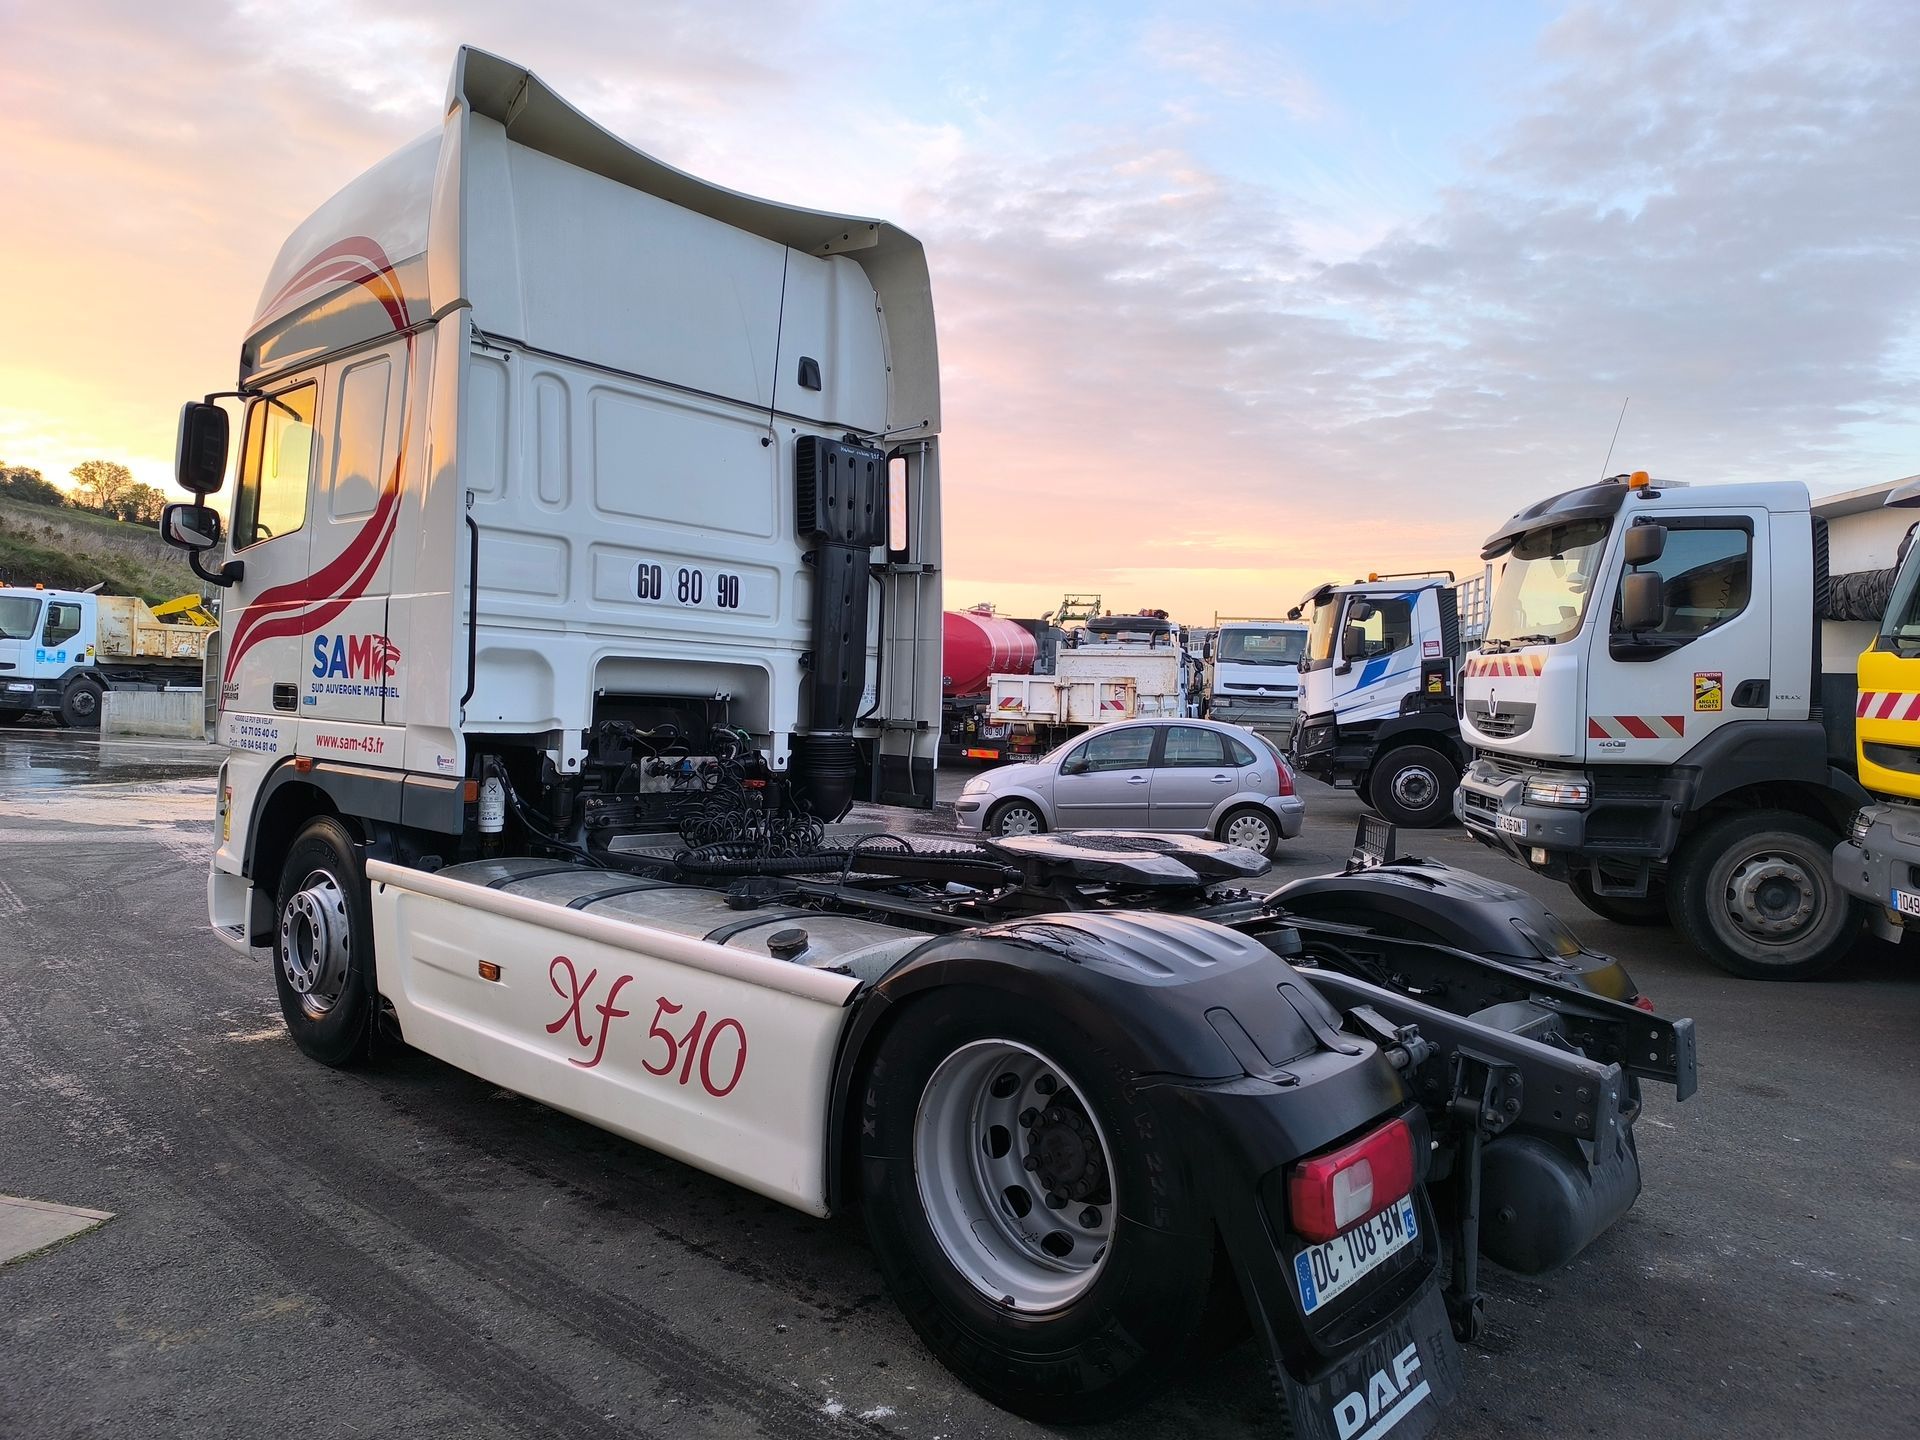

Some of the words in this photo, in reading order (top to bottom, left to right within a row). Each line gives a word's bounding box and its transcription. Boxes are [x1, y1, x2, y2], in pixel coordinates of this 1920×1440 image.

[637, 563, 662, 600] 60
[677, 568, 703, 604] 80
[717, 573, 739, 609] 90
[312, 634, 372, 680] SAM
[311, 682, 324, 693] SUD
[325, 683, 362, 695] AUVERGNE
[240, 738, 247, 748] 06
[248, 739, 254, 749] 84
[255, 740, 262, 750] 64
[269, 742, 277, 753] 40
[241, 725, 247, 735] 04
[248, 726, 254, 736] 71
[254, 727, 261, 737] 05
[261, 728, 270, 738] 40
[270, 729, 278, 739] 43
[316, 734, 385, 754] www.sam-43.fr
[641, 996, 747, 1097] 510
[1333, 1342, 1421, 1440] DAF
